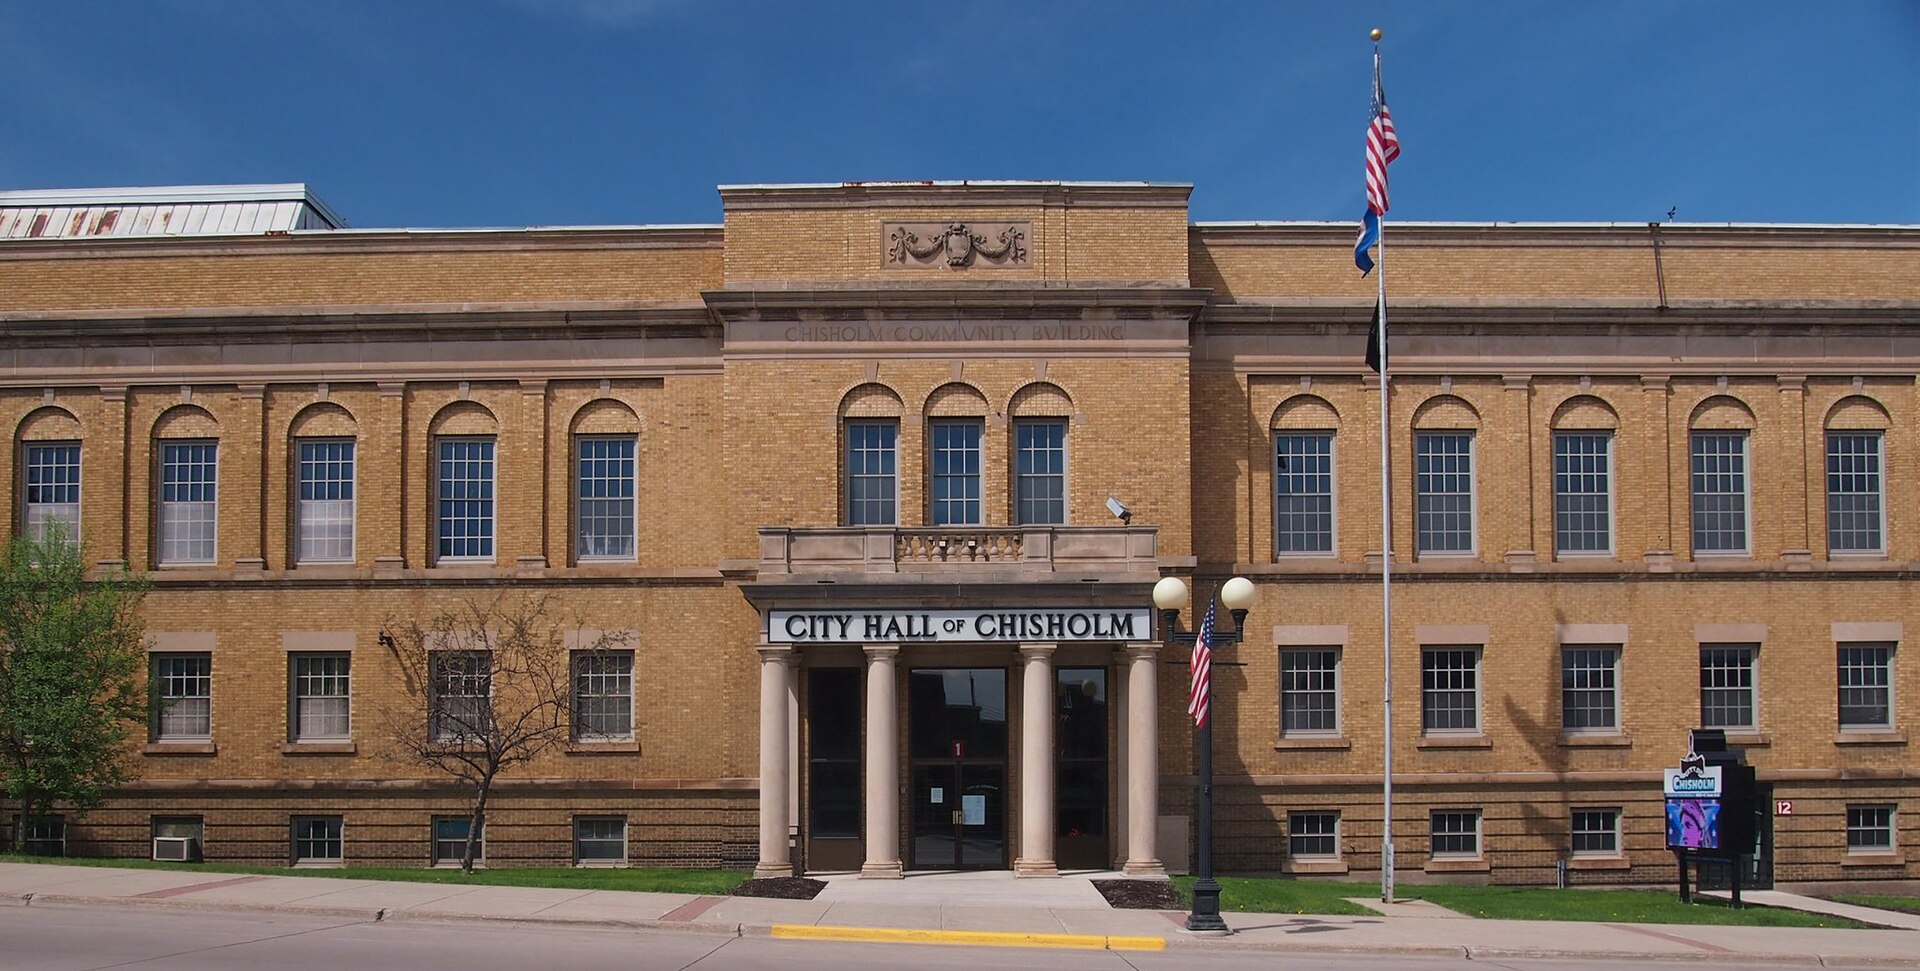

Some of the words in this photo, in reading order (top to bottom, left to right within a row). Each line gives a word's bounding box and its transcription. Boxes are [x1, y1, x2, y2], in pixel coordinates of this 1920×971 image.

[785, 326, 883, 342] CHISHOLM
[785, 614, 853, 639] CITY
[863, 614, 937, 639] HALL
[943, 619, 966, 633] OF
[974, 613, 1135, 638] CHISHOLM
[955, 742, 961, 757] 1
[1672, 776, 1715, 791] CHISHOLM
[1777, 801, 1792, 815] 12
